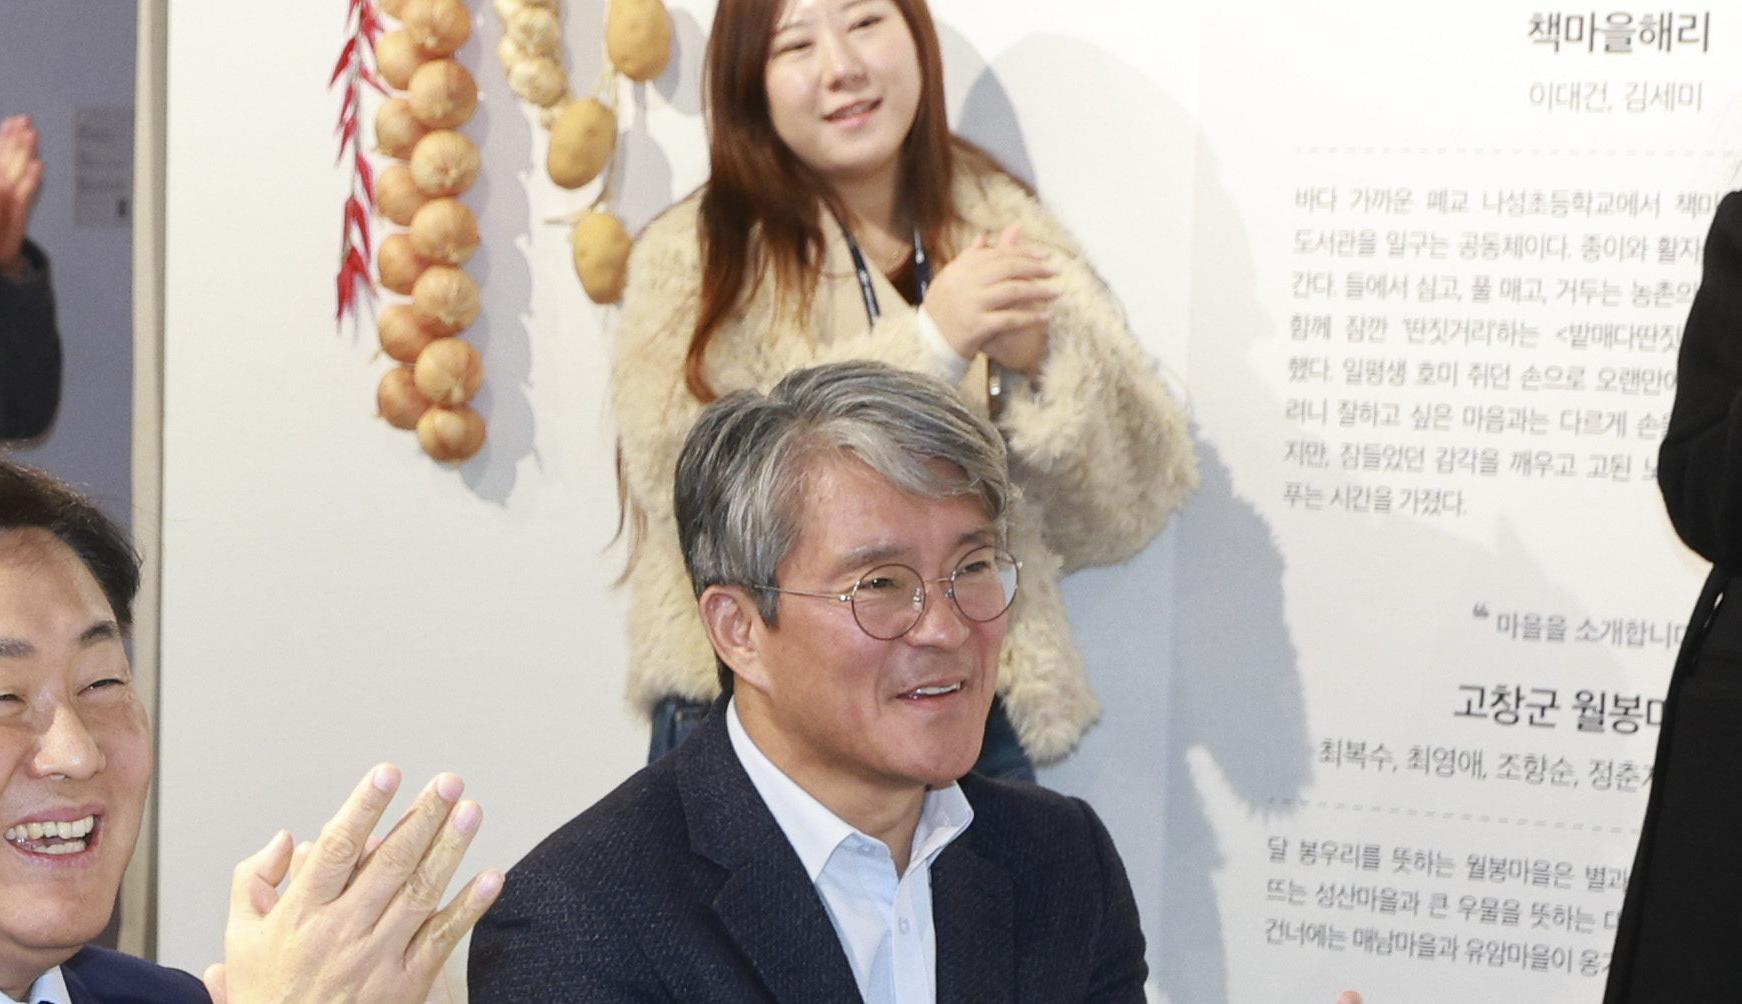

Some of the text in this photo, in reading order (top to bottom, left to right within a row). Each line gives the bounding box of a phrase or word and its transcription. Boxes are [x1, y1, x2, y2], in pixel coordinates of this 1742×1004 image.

[1528, 10, 1711, 54] 책마을해리
[1528, 80, 1704, 114] 이대건, 김세미
[1295, 186, 1337, 214] 바다
[1350, 187, 1413, 215] 가까운
[1482, 187, 1661, 218] 나성초등학교에서
[1293, 228, 1376, 258] 도서관을
[1386, 229, 1450, 259] 일구는
[1459, 231, 1572, 261] 공동체이다.
[1581, 233, 1648, 263] 종이와
[1291, 271, 1337, 300] 간다.
[1346, 271, 1409, 301] 들에서
[1472, 274, 1492, 304] 풀
[1557, 277, 1623, 307] 거두는
[1290, 312, 1332, 342] 함께
[1346, 314, 1388, 344] 잠깐
[1288, 355, 1334, 384] 했다.
[1343, 356, 1407, 387] 일평생
[1416, 358, 1458, 388] 호미
[1521, 363, 1587, 392] 손으로
[1285, 398, 1328, 426] 러니
[1338, 399, 1401, 428] 잘하고
[1411, 402, 1453, 431] 싶은
[1461, 403, 1550, 436] 마음과는
[1560, 408, 1628, 438] 다르게
[1340, 442, 1425, 473] 잠들었던
[1435, 444, 1499, 476] 감각을
[1510, 448, 1577, 480] 깨우고
[1586, 452, 1632, 482] 고된
[1282, 481, 1467, 518] 푸는 시간을 가졌다.
[1497, 611, 1567, 644] 마을을
[1453, 683, 1562, 728] 고창군
[1319, 738, 1397, 773] 최복수,
[1407, 744, 1488, 780] 최영애,
[1267, 835, 1288, 864] 달
[1299, 838, 1382, 872] 봉우리를
[1392, 846, 1455, 879] 뜻하는
[1466, 852, 1575, 890] 월봉마을은
[1266, 878, 1307, 907] 뜨는
[1315, 880, 1421, 918] 성산마을과
[1429, 892, 1450, 920] 큰
[1457, 894, 1522, 928] 우물을
[1529, 900, 1597, 935] 뜻하는
[1265, 917, 1349, 952] 건너에는
[1352, 926, 1458, 964] 매남마을과
[1465, 937, 1574, 975] 유암마을이
